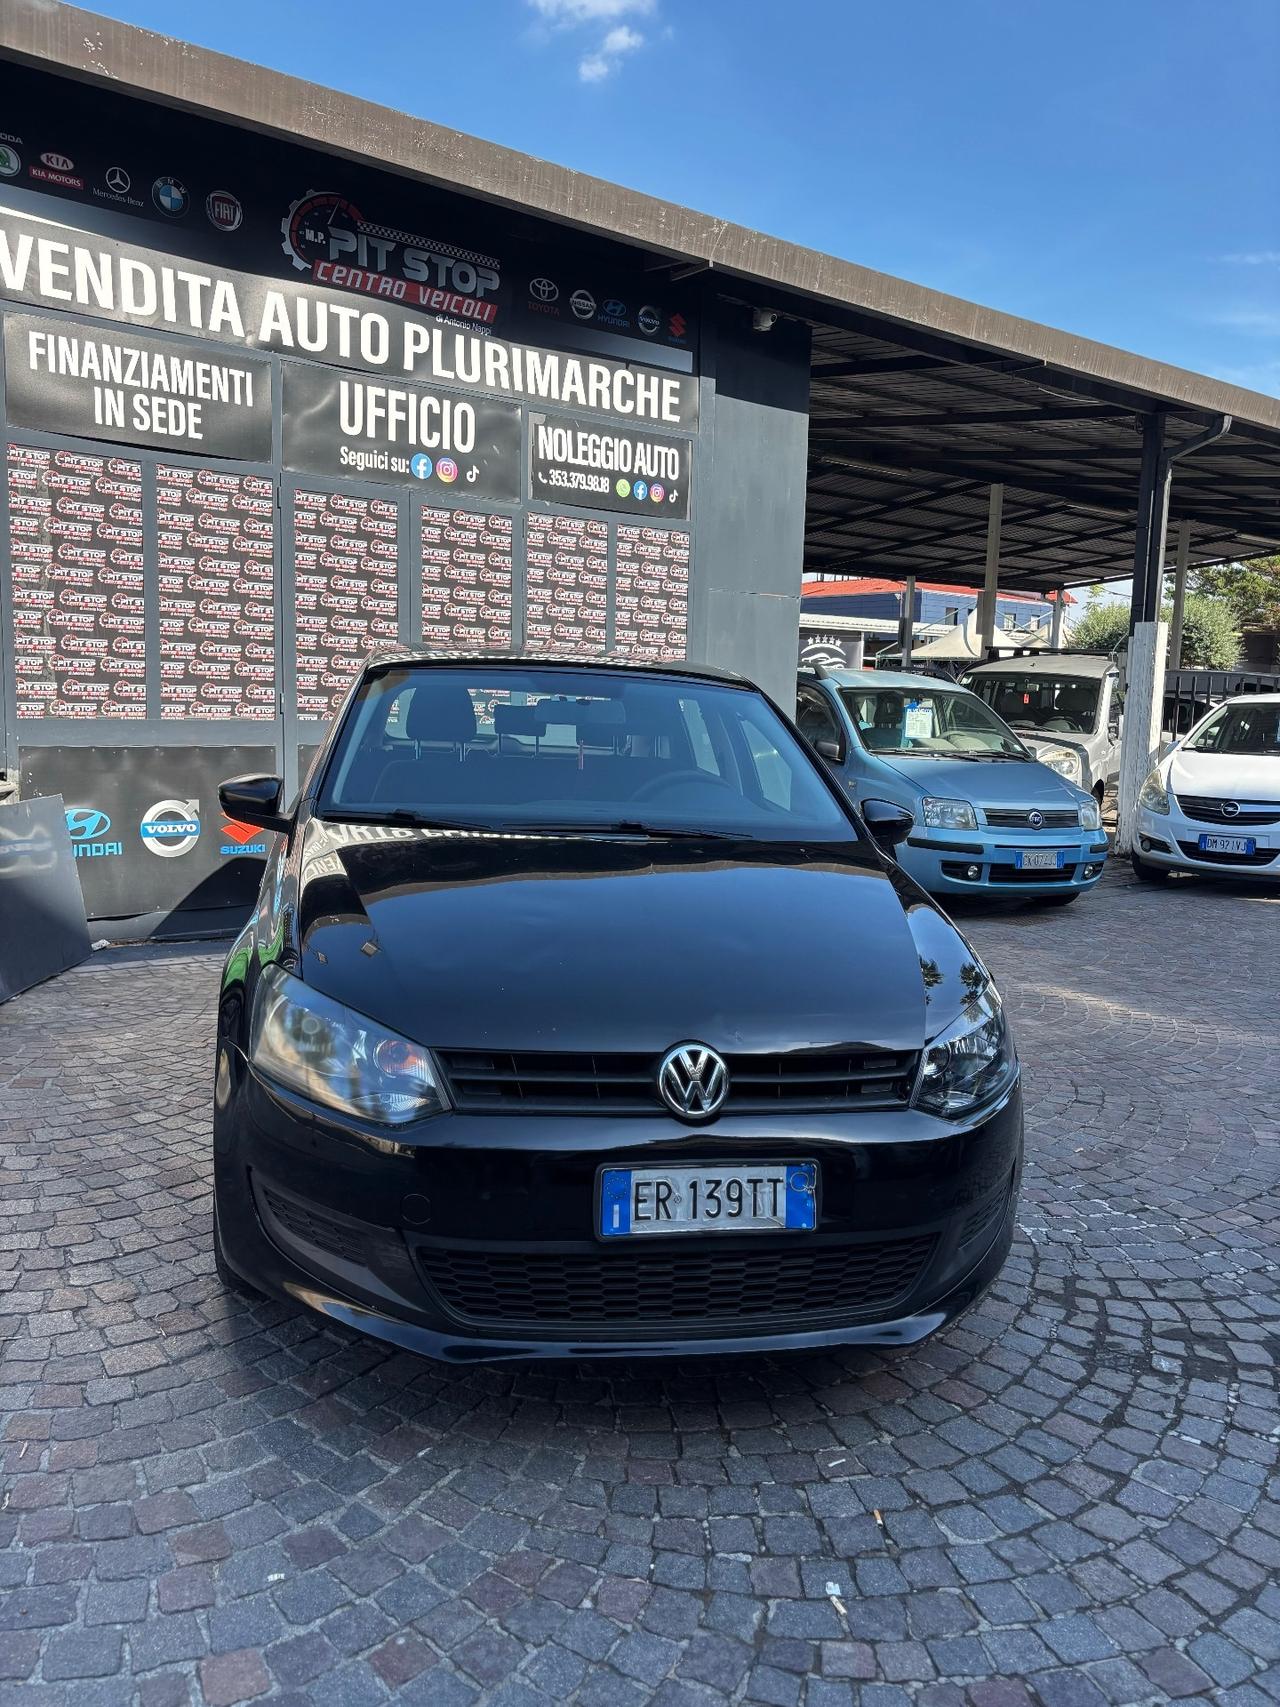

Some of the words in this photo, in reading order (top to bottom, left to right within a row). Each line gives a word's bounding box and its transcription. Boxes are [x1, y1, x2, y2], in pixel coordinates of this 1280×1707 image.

[46, 154, 70, 169] KIA
[32, 168, 46, 178] KIA
[48, 171, 81, 187] MOTORS
[214, 201, 235, 221] FIAT
[305, 228, 327, 244] M.P.
[328, 226, 396, 272] PIT
[402, 249, 500, 298] STOP
[528, 301, 560, 317] TOYOTA
[572, 300, 594, 310] NISSAN
[0, 229, 245, 338] VENDITA
[259, 290, 389, 366] AUTO
[404, 321, 681, 423] PLURIMARCHE
[444, 315, 471, 330] Antonio
[472, 323, 492, 336] Nappi
[598, 315, 630, 328] HYUNDAI
[639, 316, 660, 326] VOLVO
[28, 331, 253, 407] FINANZIAMENTI
[94, 386, 125, 428] IN
[133, 393, 203, 440] SEDE
[340, 380, 475, 454] UFFICIO
[26, 451, 50, 460] STOP
[538, 425, 632, 473] NOLEGGIO
[634, 442, 680, 480] AUTO
[81, 458, 103, 467] STOP
[340, 446, 389, 471] Seguici
[391, 458, 410, 474] su:
[12, 471, 37, 479] STOP
[67, 478, 91, 486] STOP
[104, 483, 118, 491] PIT
[11, 497, 26, 505] PIT
[27, 498, 52, 507] STOP
[208, 495, 228, 503] STOP
[253, 500, 272, 508] STOP
[82, 504, 105, 512] STOP
[53, 522, 67, 530] PIT
[68, 524, 92, 532] STOP
[106, 528, 119, 536] PIT
[121, 529, 142, 537] STOP
[13, 544, 27, 552] PIT
[68, 549, 82, 557] PIT
[82, 550, 106, 558] STOP
[107, 573, 121, 581] PIT
[72, 615, 94, 623] STOP
[109, 617, 123, 625] PIT
[123, 618, 144, 626] STOP
[16, 637, 30, 645] PIT
[70, 640, 84, 648] PIT
[19, 658, 43, 666] STOP
[58, 660, 72, 668] PIT
[144, 823, 197, 834] VOLVO
[220, 844, 266, 855] SUZUKI
[634, 1180, 673, 1221] ER
[688, 1178, 784, 1220] 139TT
